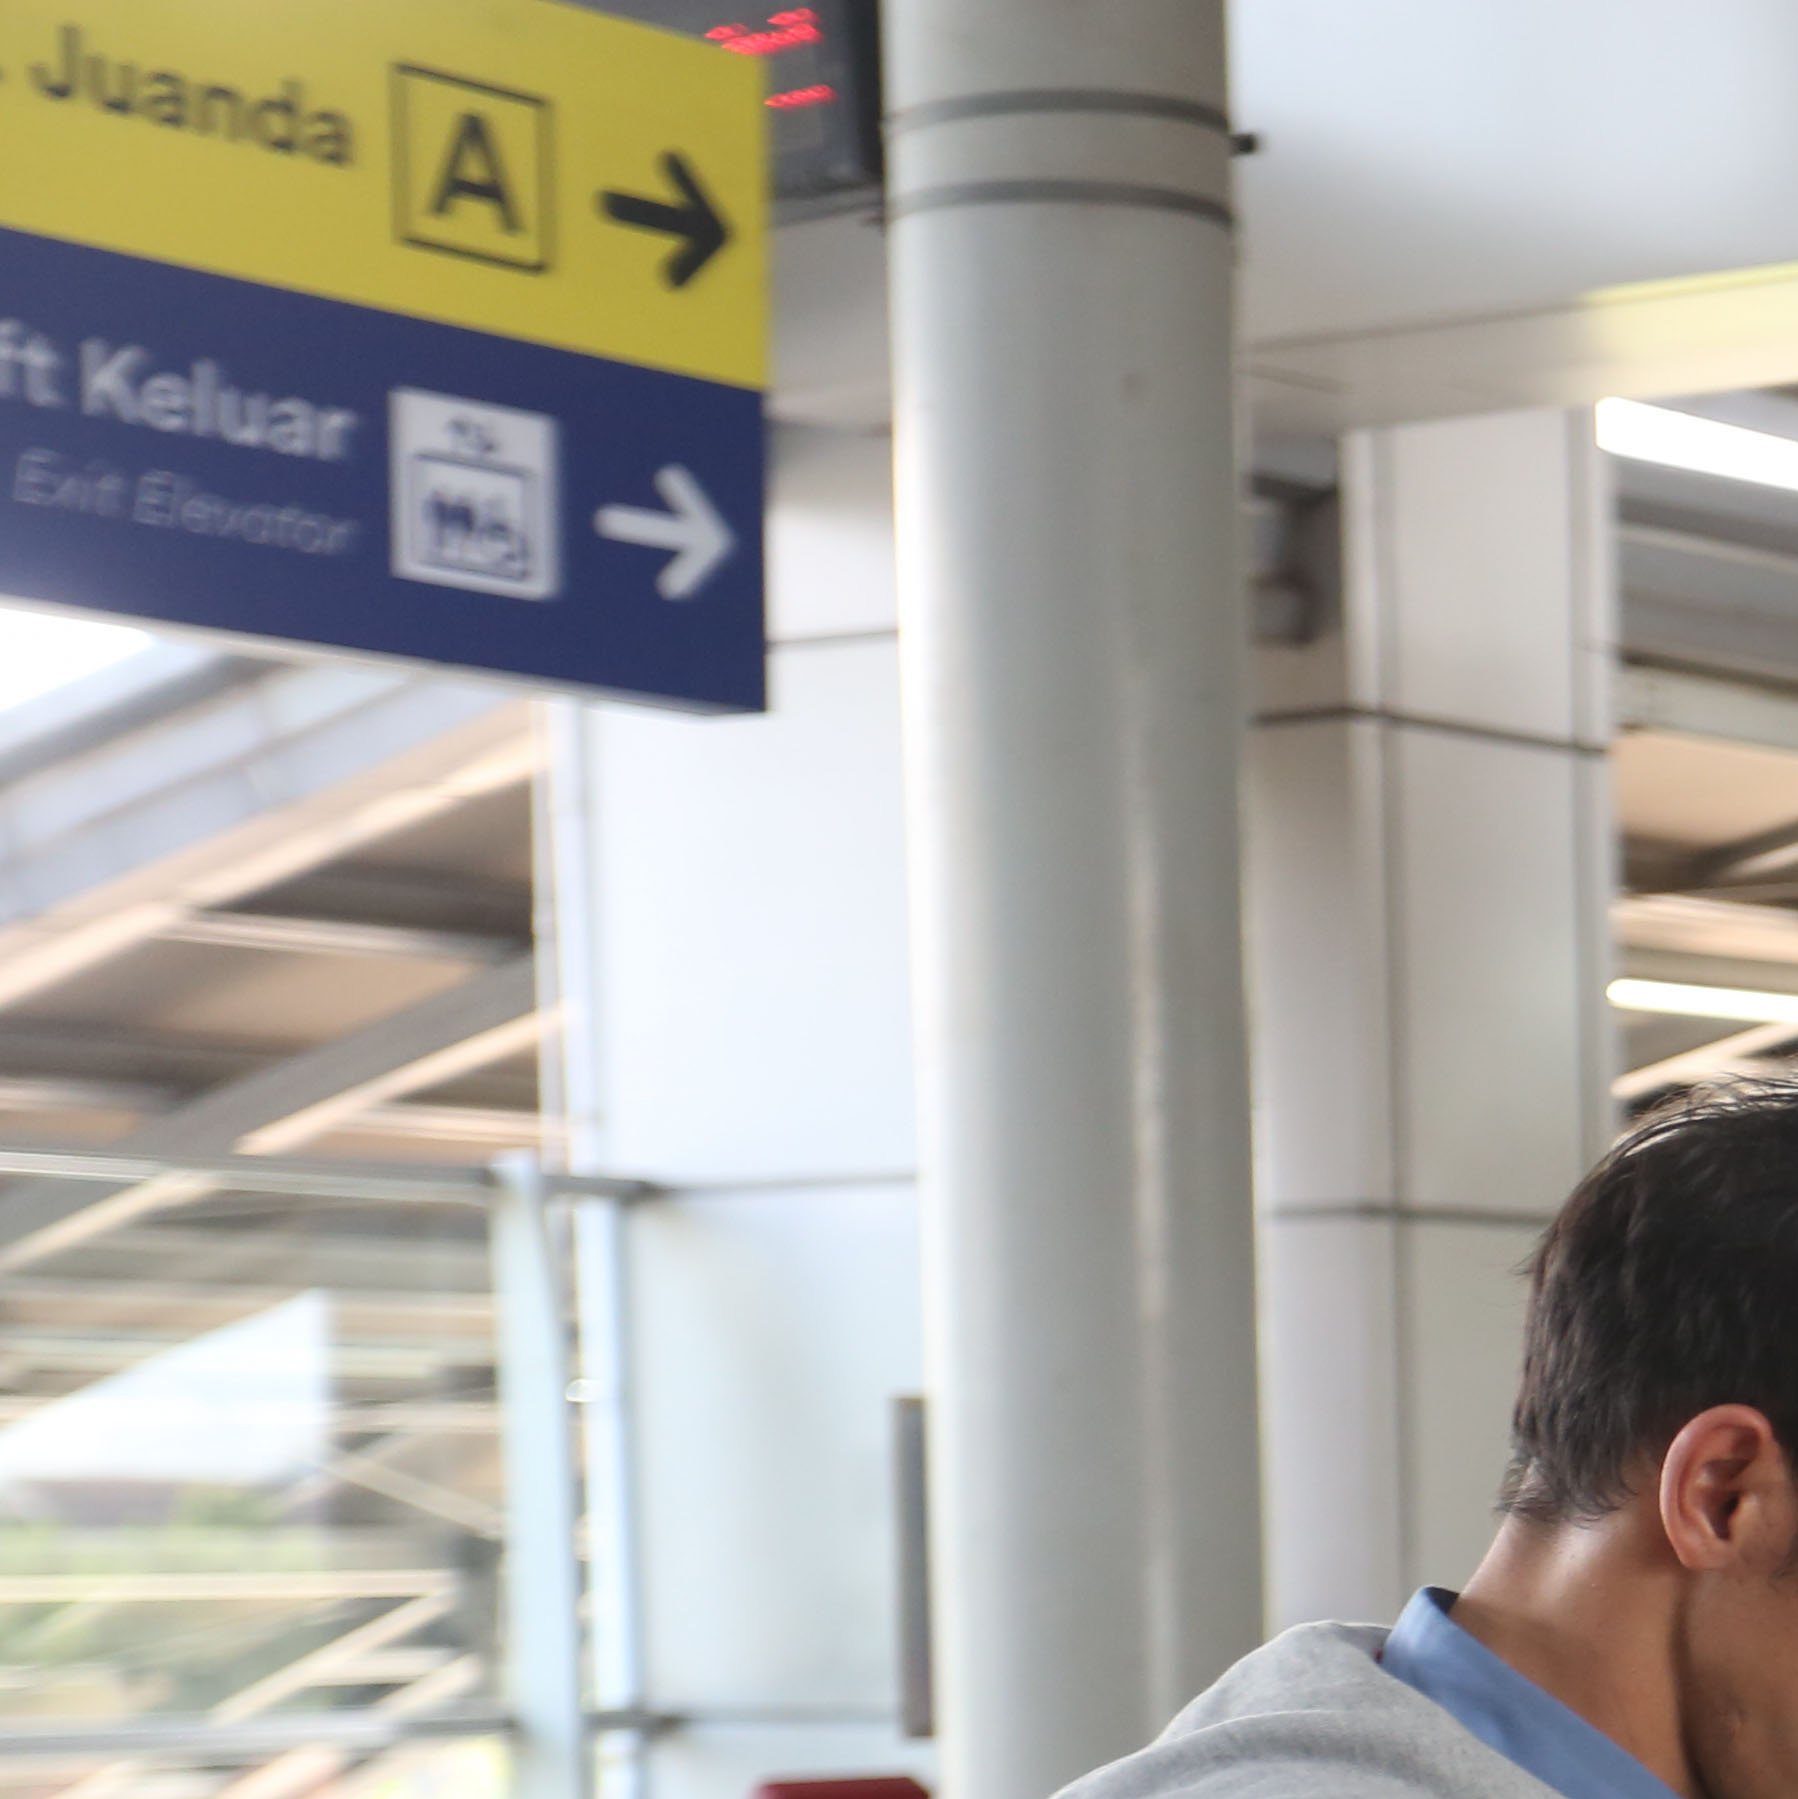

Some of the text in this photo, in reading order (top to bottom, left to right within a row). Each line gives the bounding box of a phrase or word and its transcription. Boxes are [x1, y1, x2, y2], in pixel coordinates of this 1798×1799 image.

[26, 24, 354, 168] Juanda
[428, 112, 524, 235] A
[80, 336, 357, 462] Keluar
